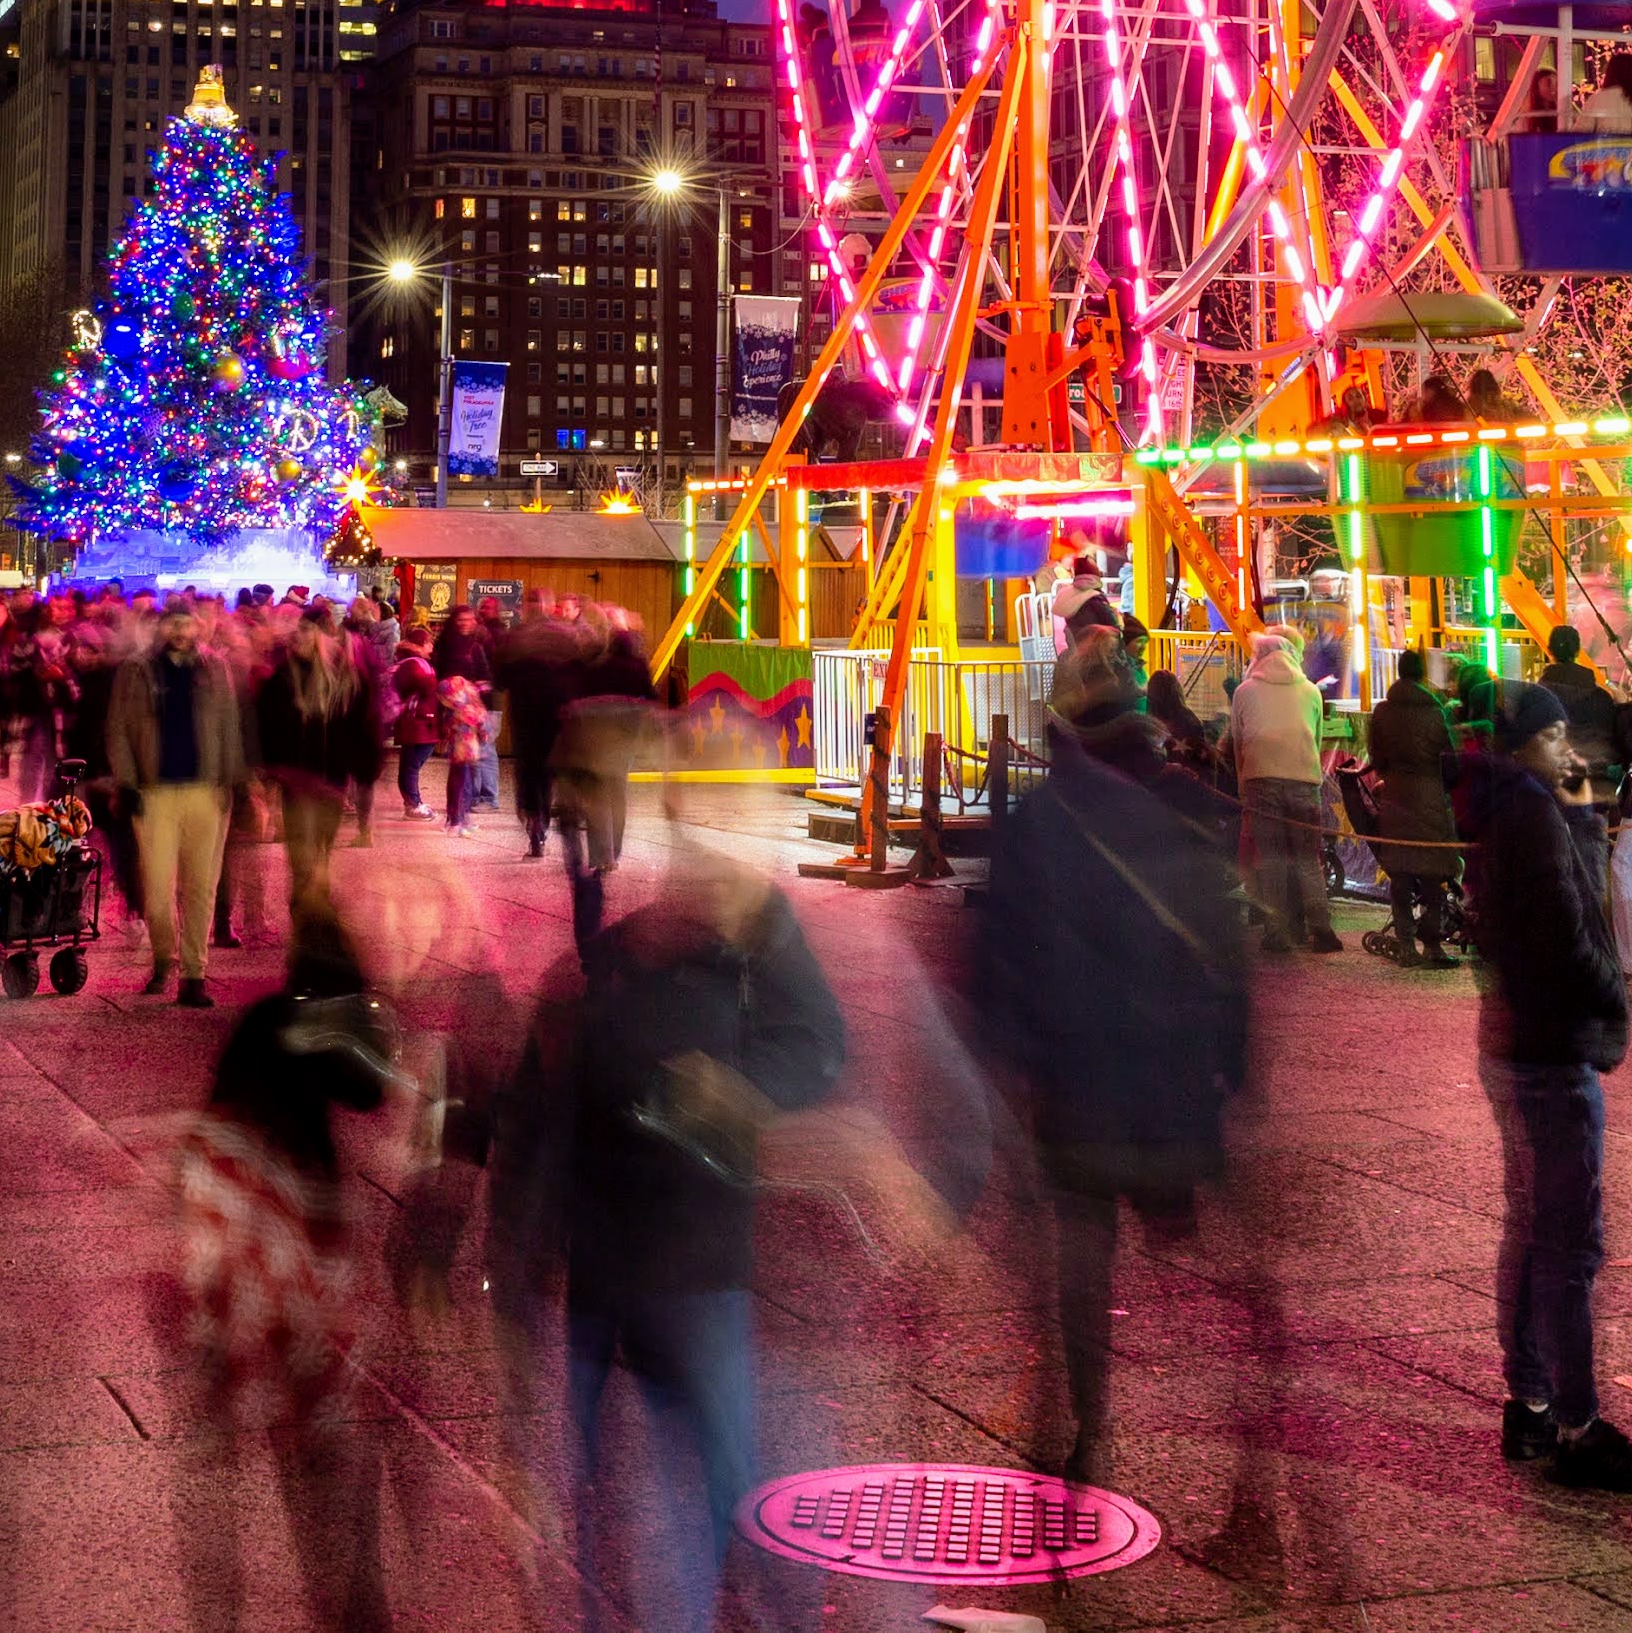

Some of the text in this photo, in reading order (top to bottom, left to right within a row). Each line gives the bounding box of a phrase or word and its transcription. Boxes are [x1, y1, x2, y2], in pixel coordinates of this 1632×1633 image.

[751, 348, 781, 366] Philly
[460, 408, 494, 424] Holiday
[468, 420, 488, 433] Tree
[478, 584, 513, 594] TICKETS
